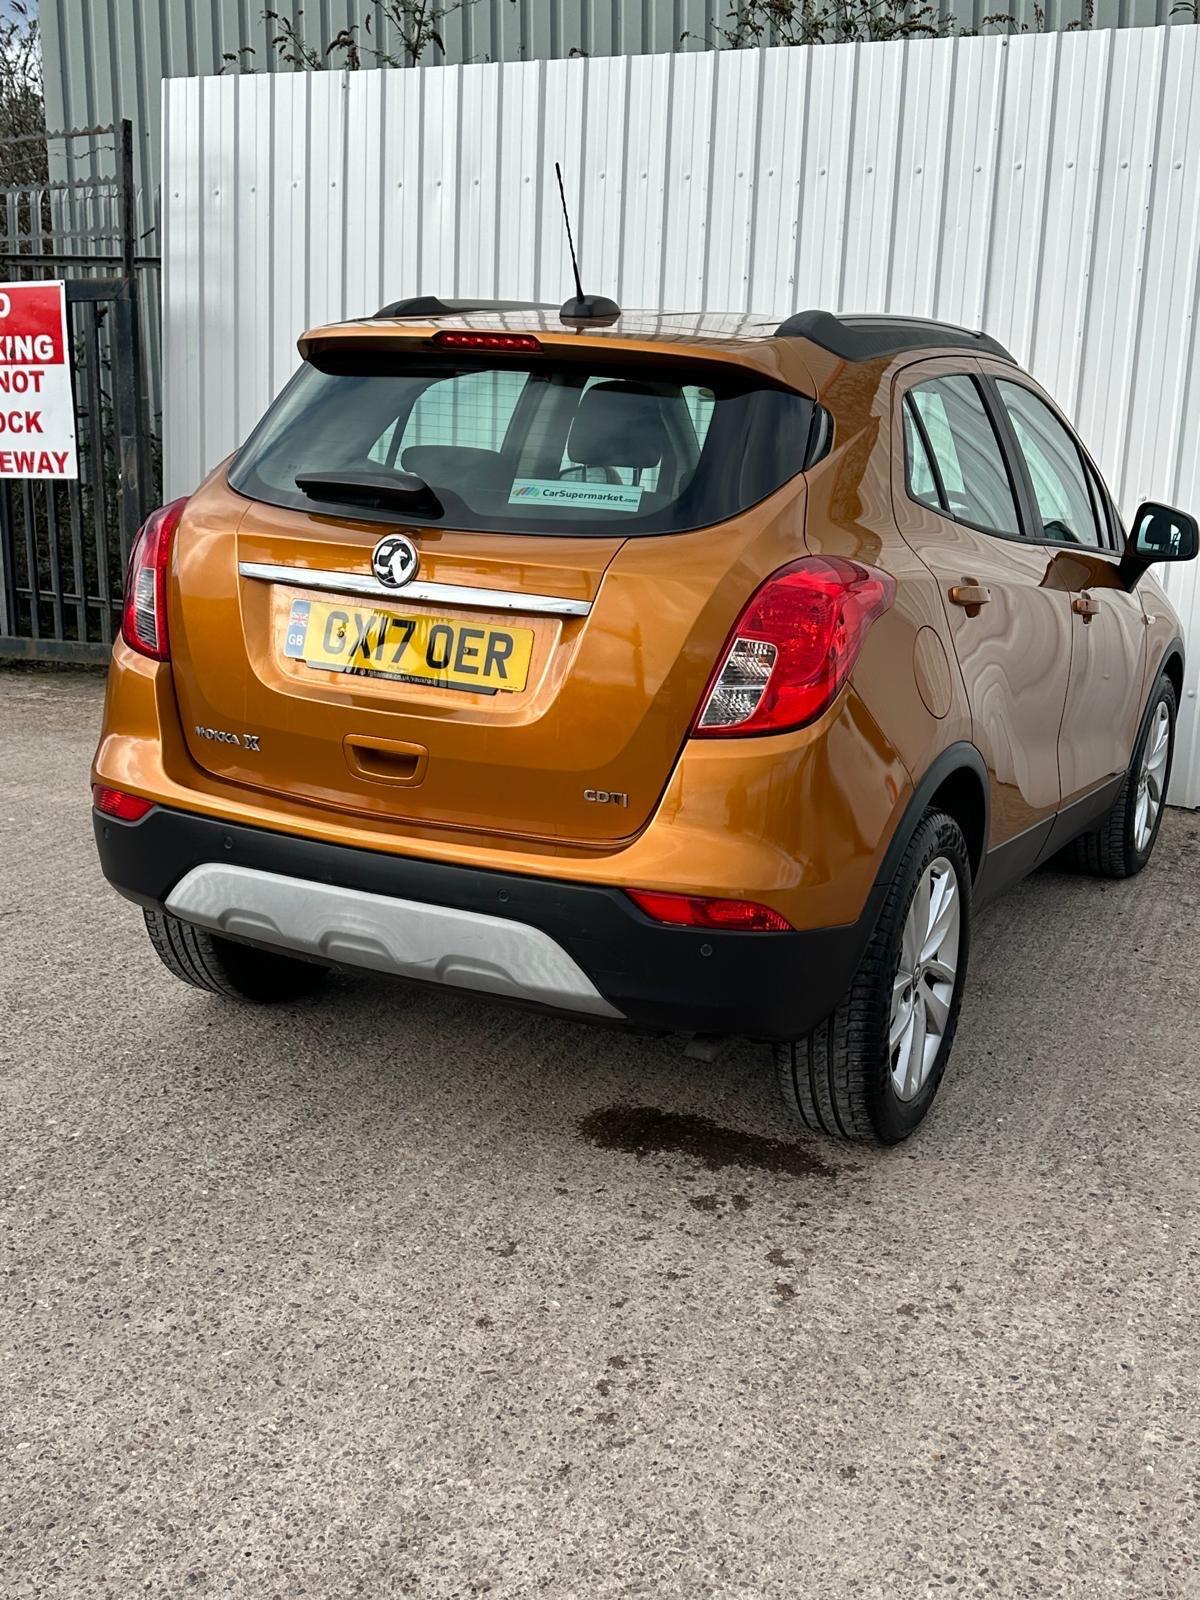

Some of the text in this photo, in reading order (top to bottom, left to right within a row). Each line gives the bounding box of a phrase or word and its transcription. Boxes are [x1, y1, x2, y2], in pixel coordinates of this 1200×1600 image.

[0, 451, 69, 473] EWAY
[542, 489, 638, 504] CarSupermarket.com
[288, 633, 304, 646] GB
[323, 611, 514, 679] GX17 OER
[195, 726, 260, 752] MOKKA X
